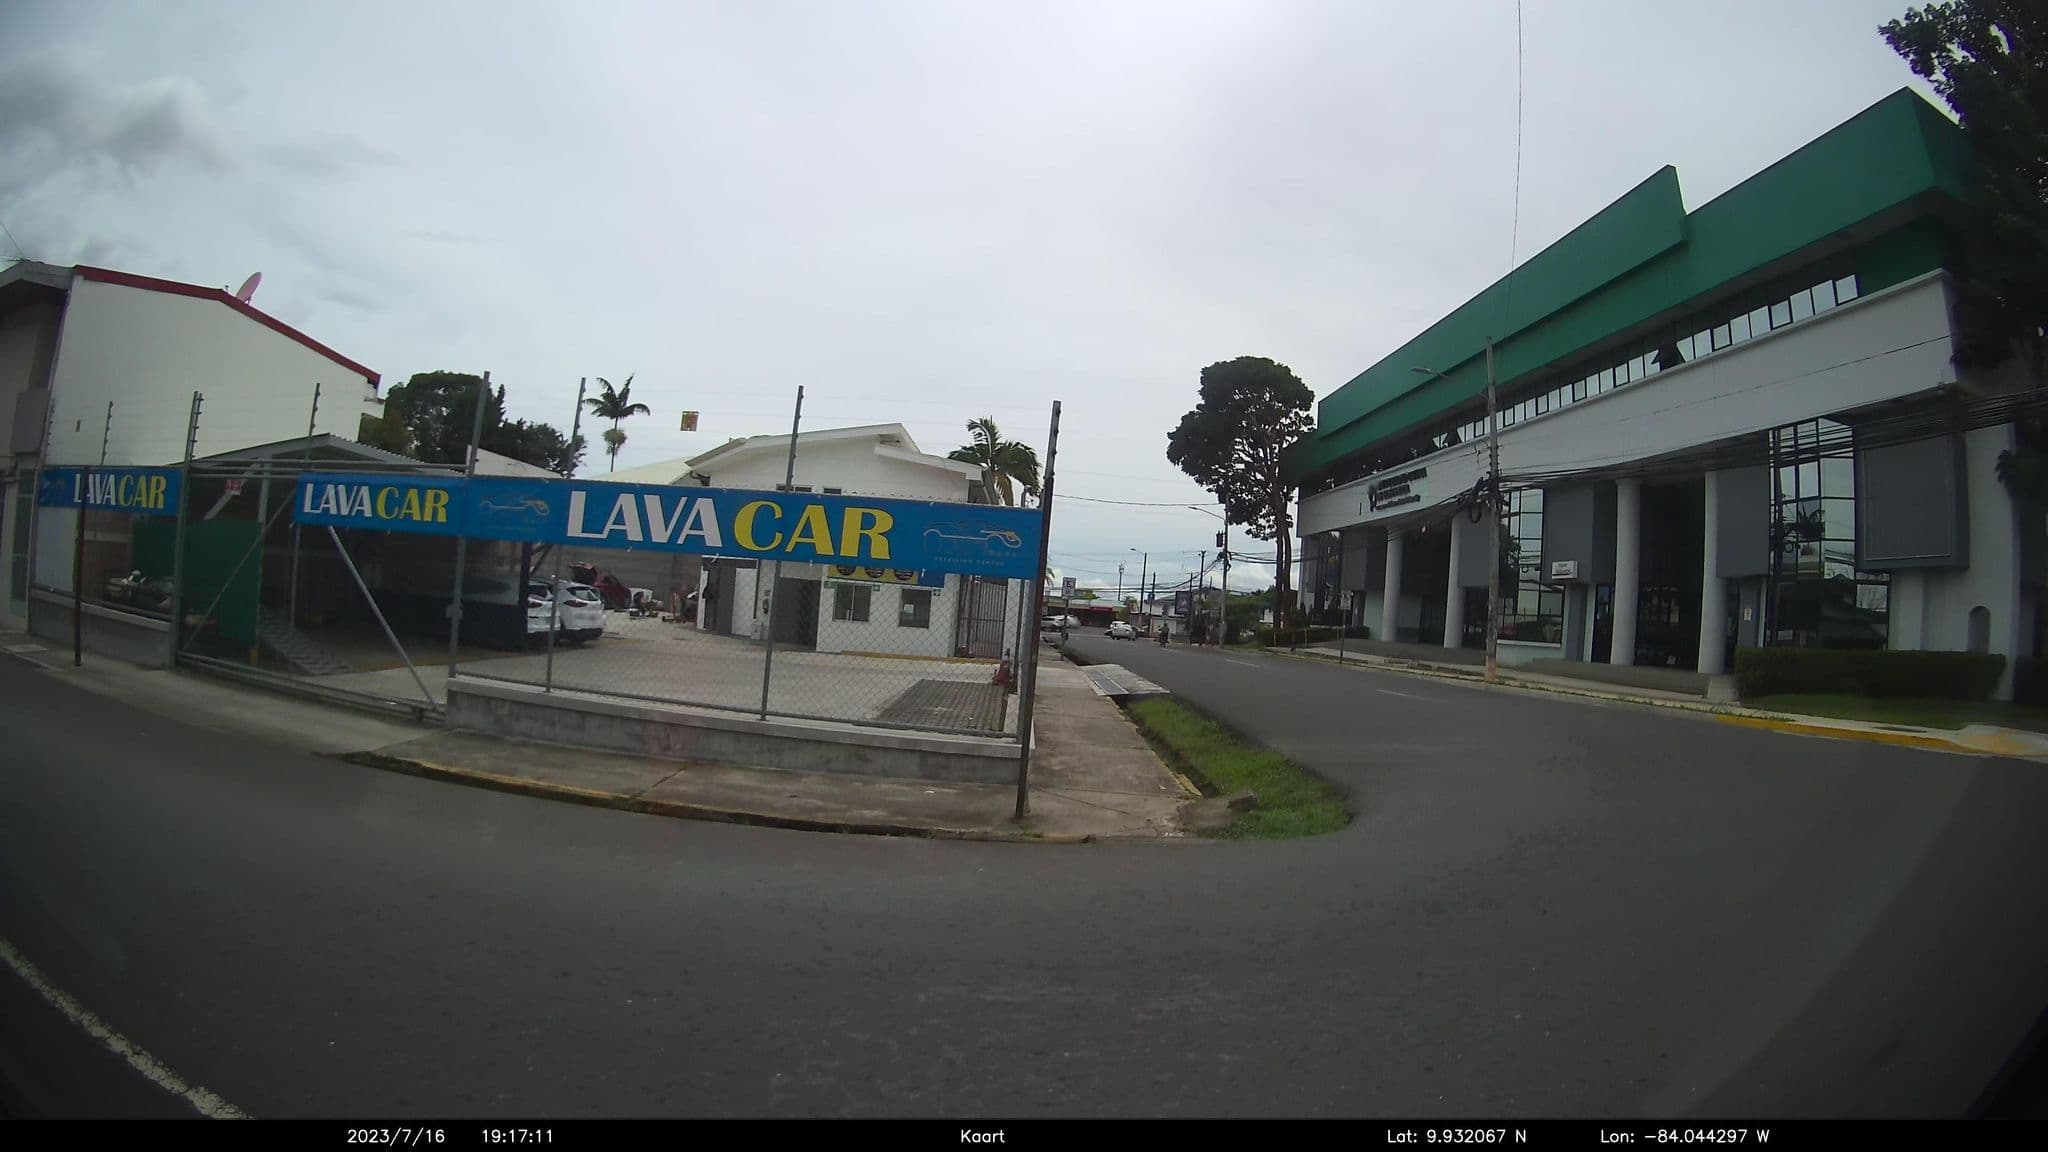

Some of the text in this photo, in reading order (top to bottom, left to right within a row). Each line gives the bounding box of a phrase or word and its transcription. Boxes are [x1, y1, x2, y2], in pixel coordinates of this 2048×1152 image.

[74, 473, 168, 510] LAVA CAR
[302, 483, 450, 524] LAVA CAR
[566, 490, 895, 561] LAVA CAR
